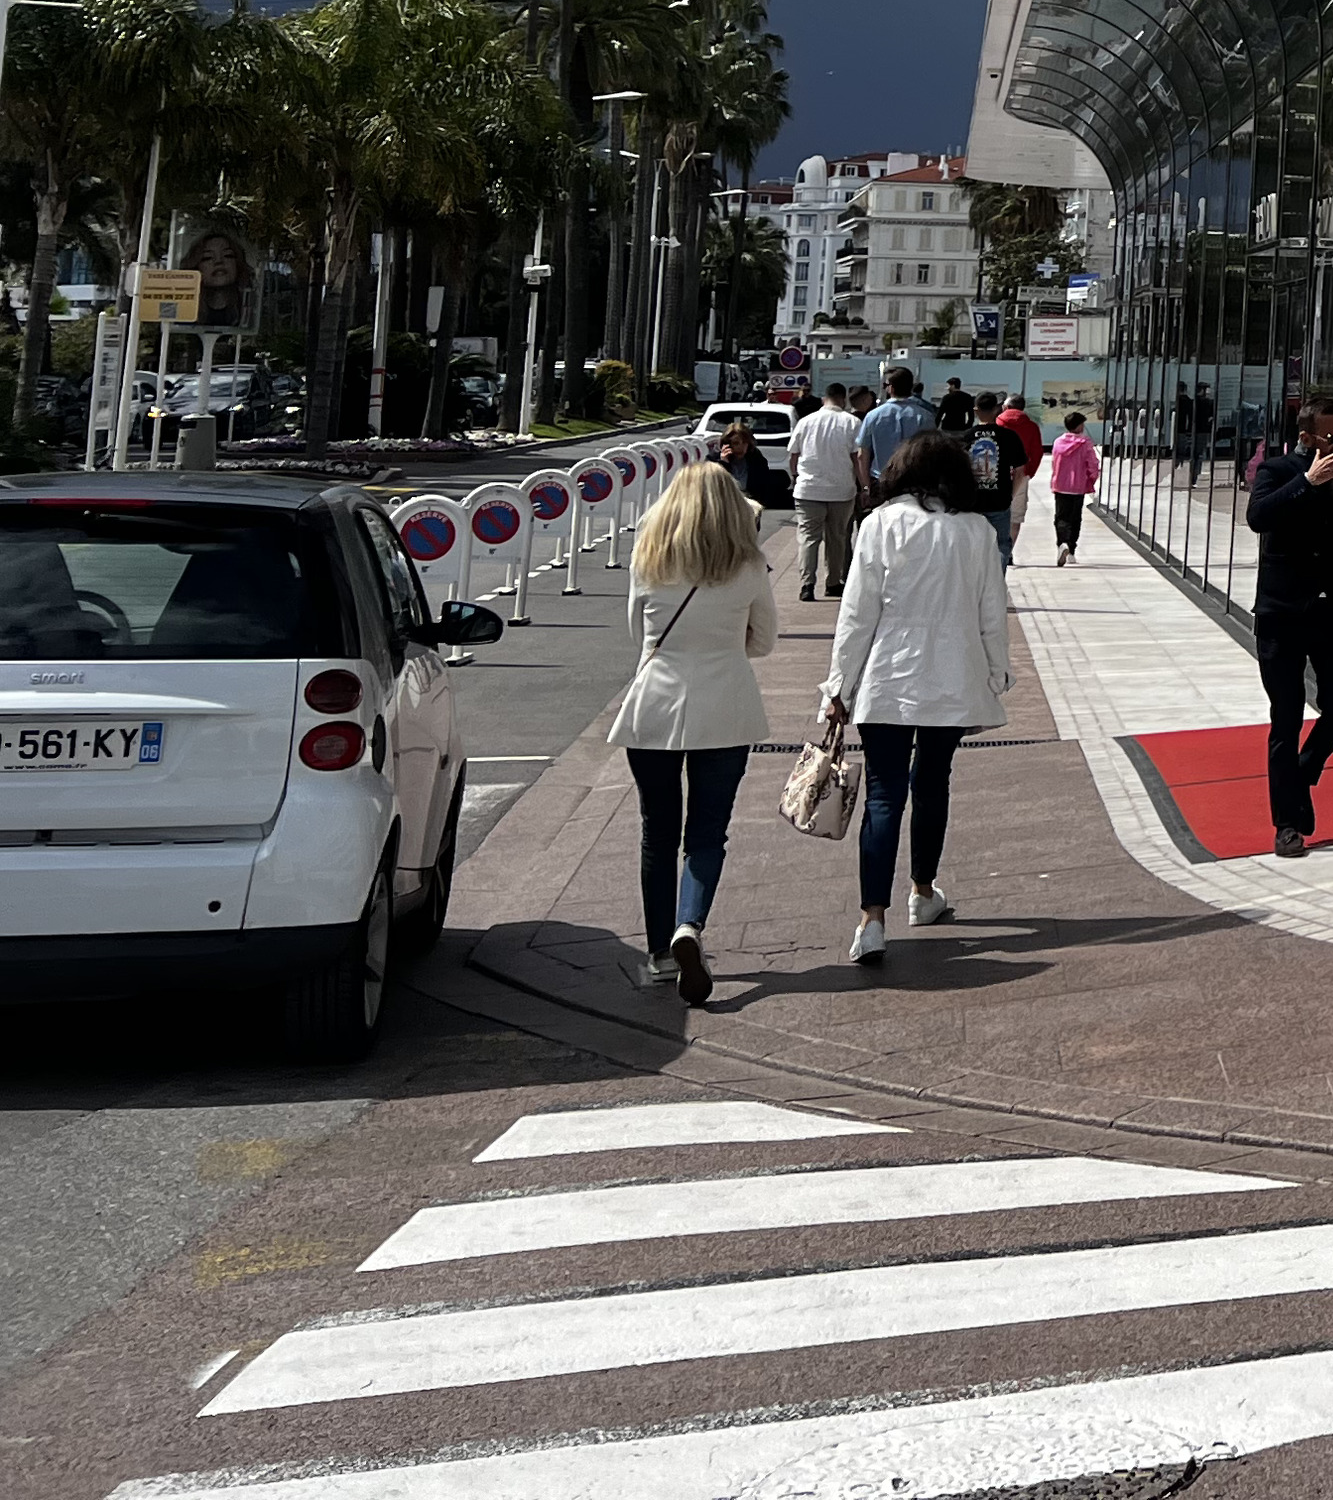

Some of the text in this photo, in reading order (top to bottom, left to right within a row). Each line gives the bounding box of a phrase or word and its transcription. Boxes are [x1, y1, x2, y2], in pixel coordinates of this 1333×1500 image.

[975, 313, 985, 327] P
[30, 670, 85, 685] smart
[141, 744, 158, 759] 06
